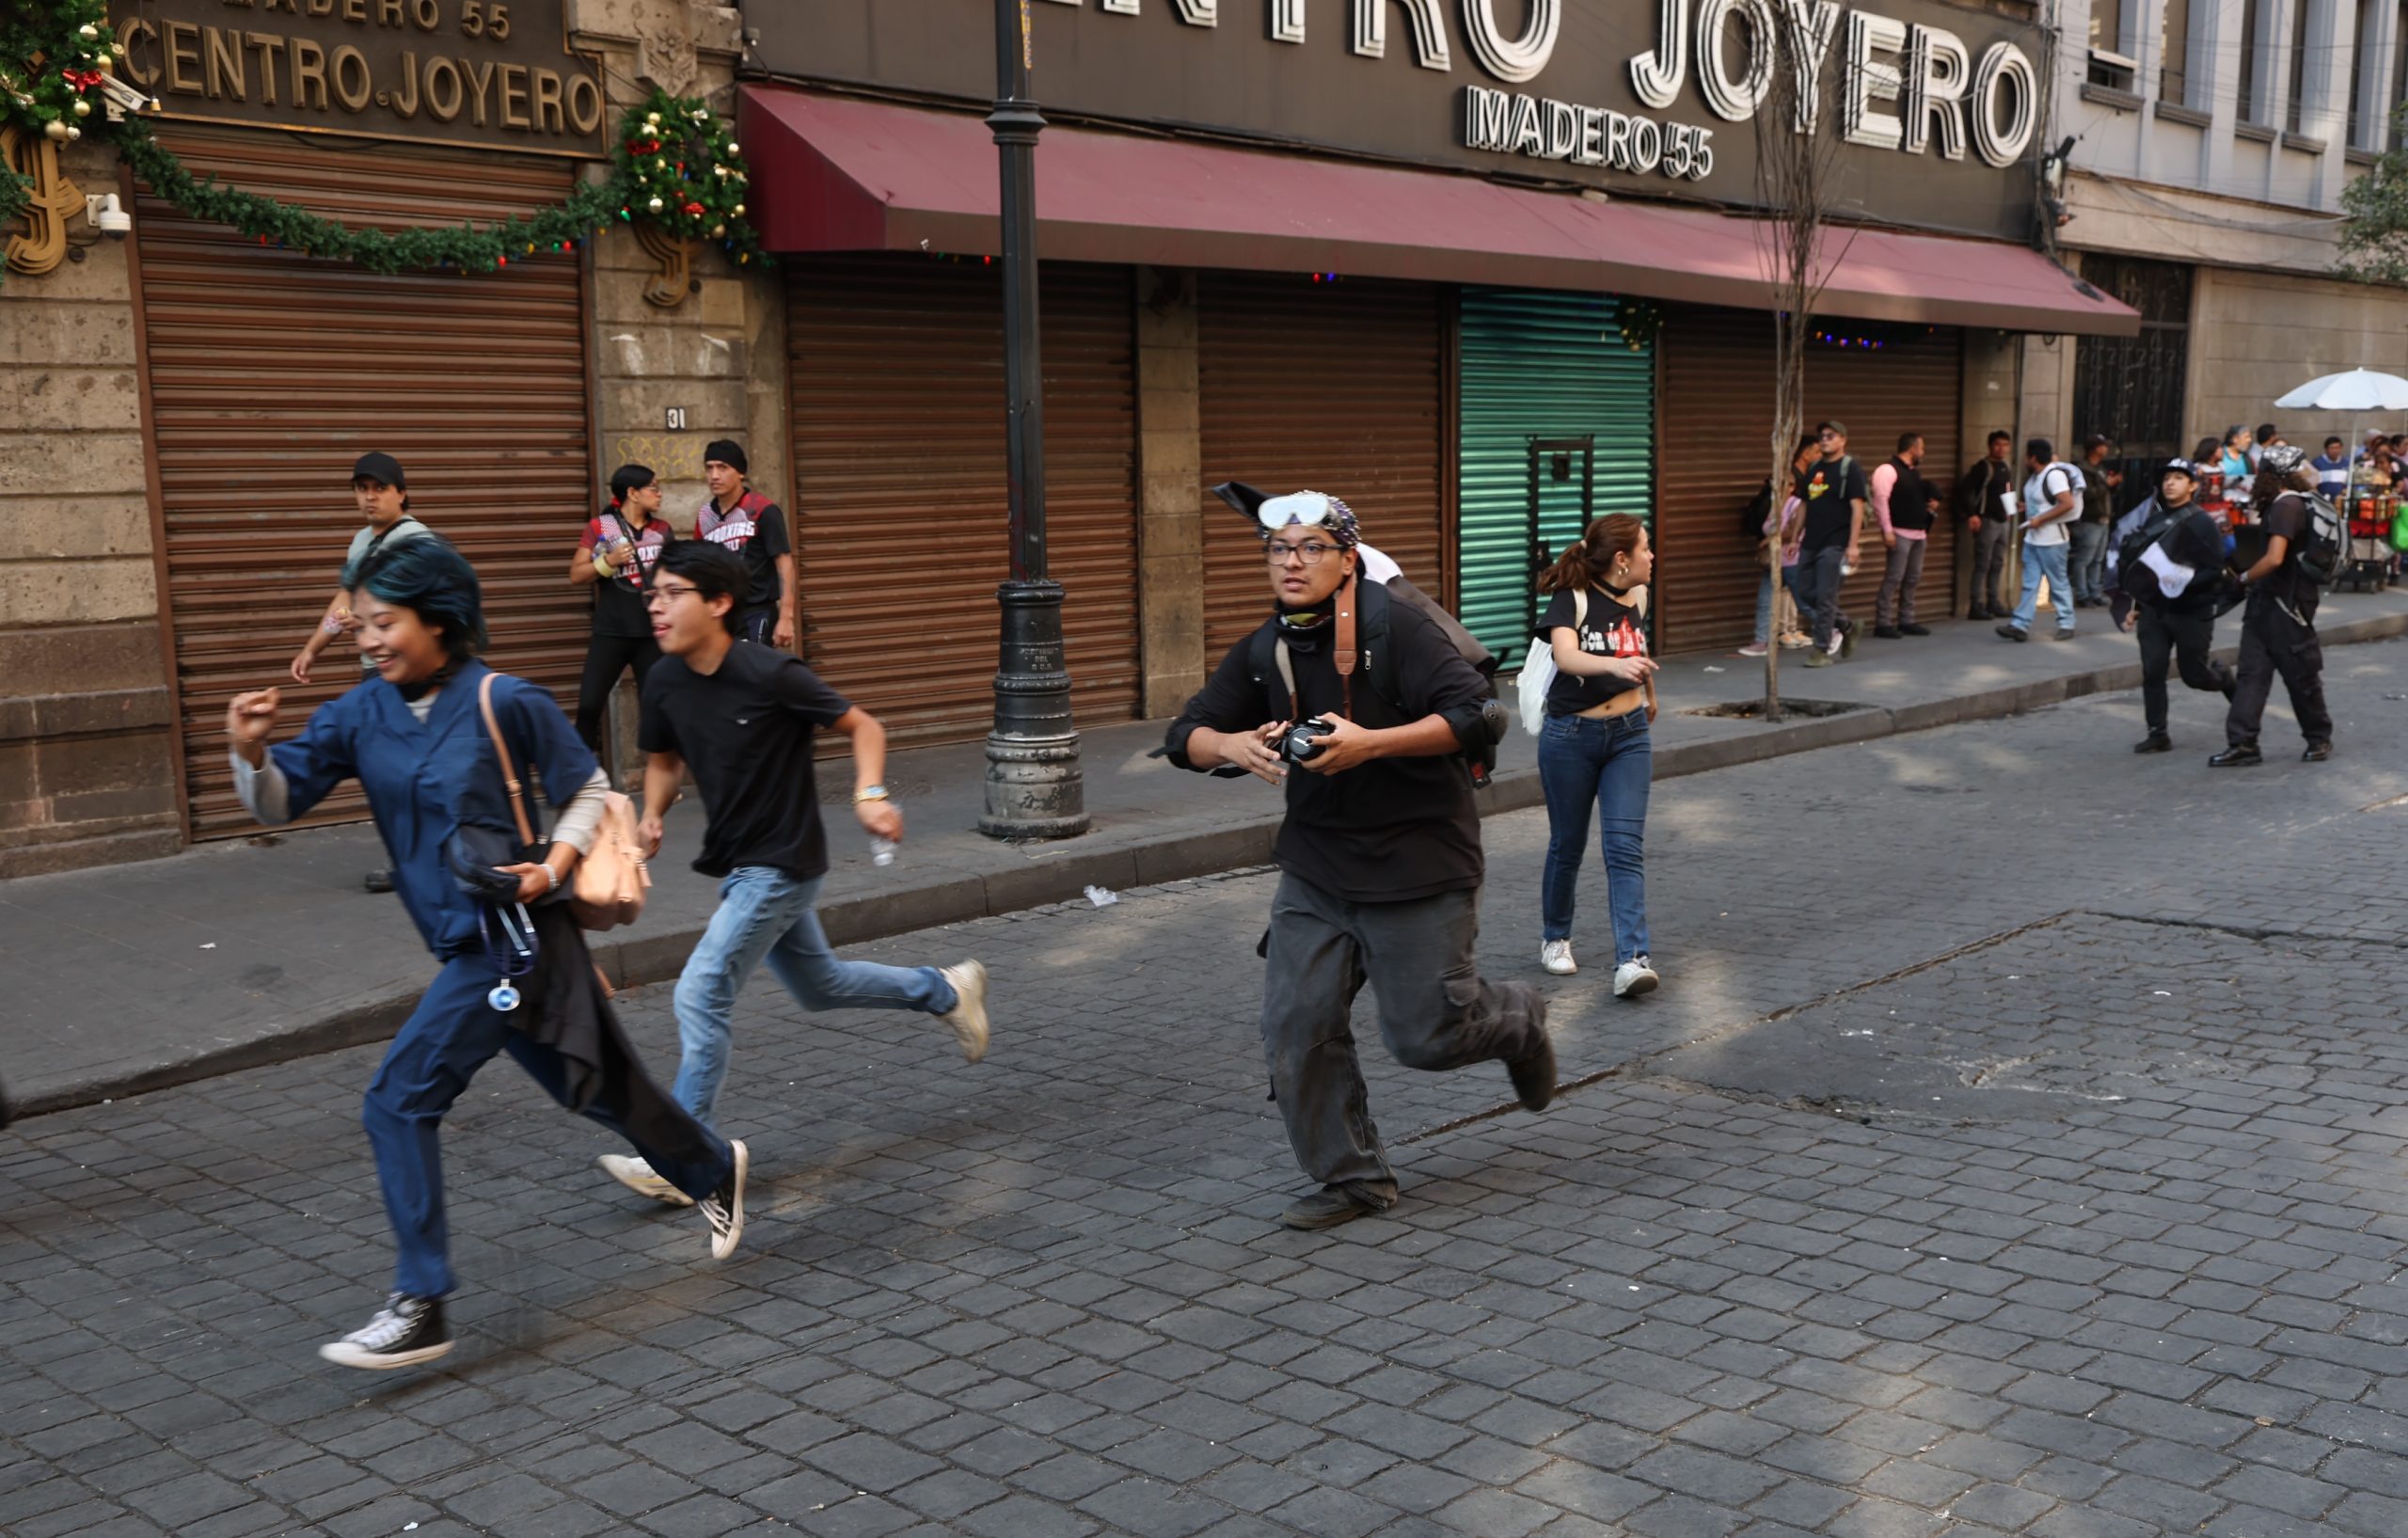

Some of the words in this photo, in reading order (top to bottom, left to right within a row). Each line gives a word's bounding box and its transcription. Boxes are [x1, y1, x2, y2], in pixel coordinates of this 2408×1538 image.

[461, 0, 511, 40] 55
[116, 16, 372, 113] CENTRO
[390, 51, 602, 136] JOYERO
[1629, 0, 2037, 168] JOYERO
[1466, 85, 1662, 174] MADERO
[1663, 121, 1714, 182] 55
[667, 407, 686, 429] 31
